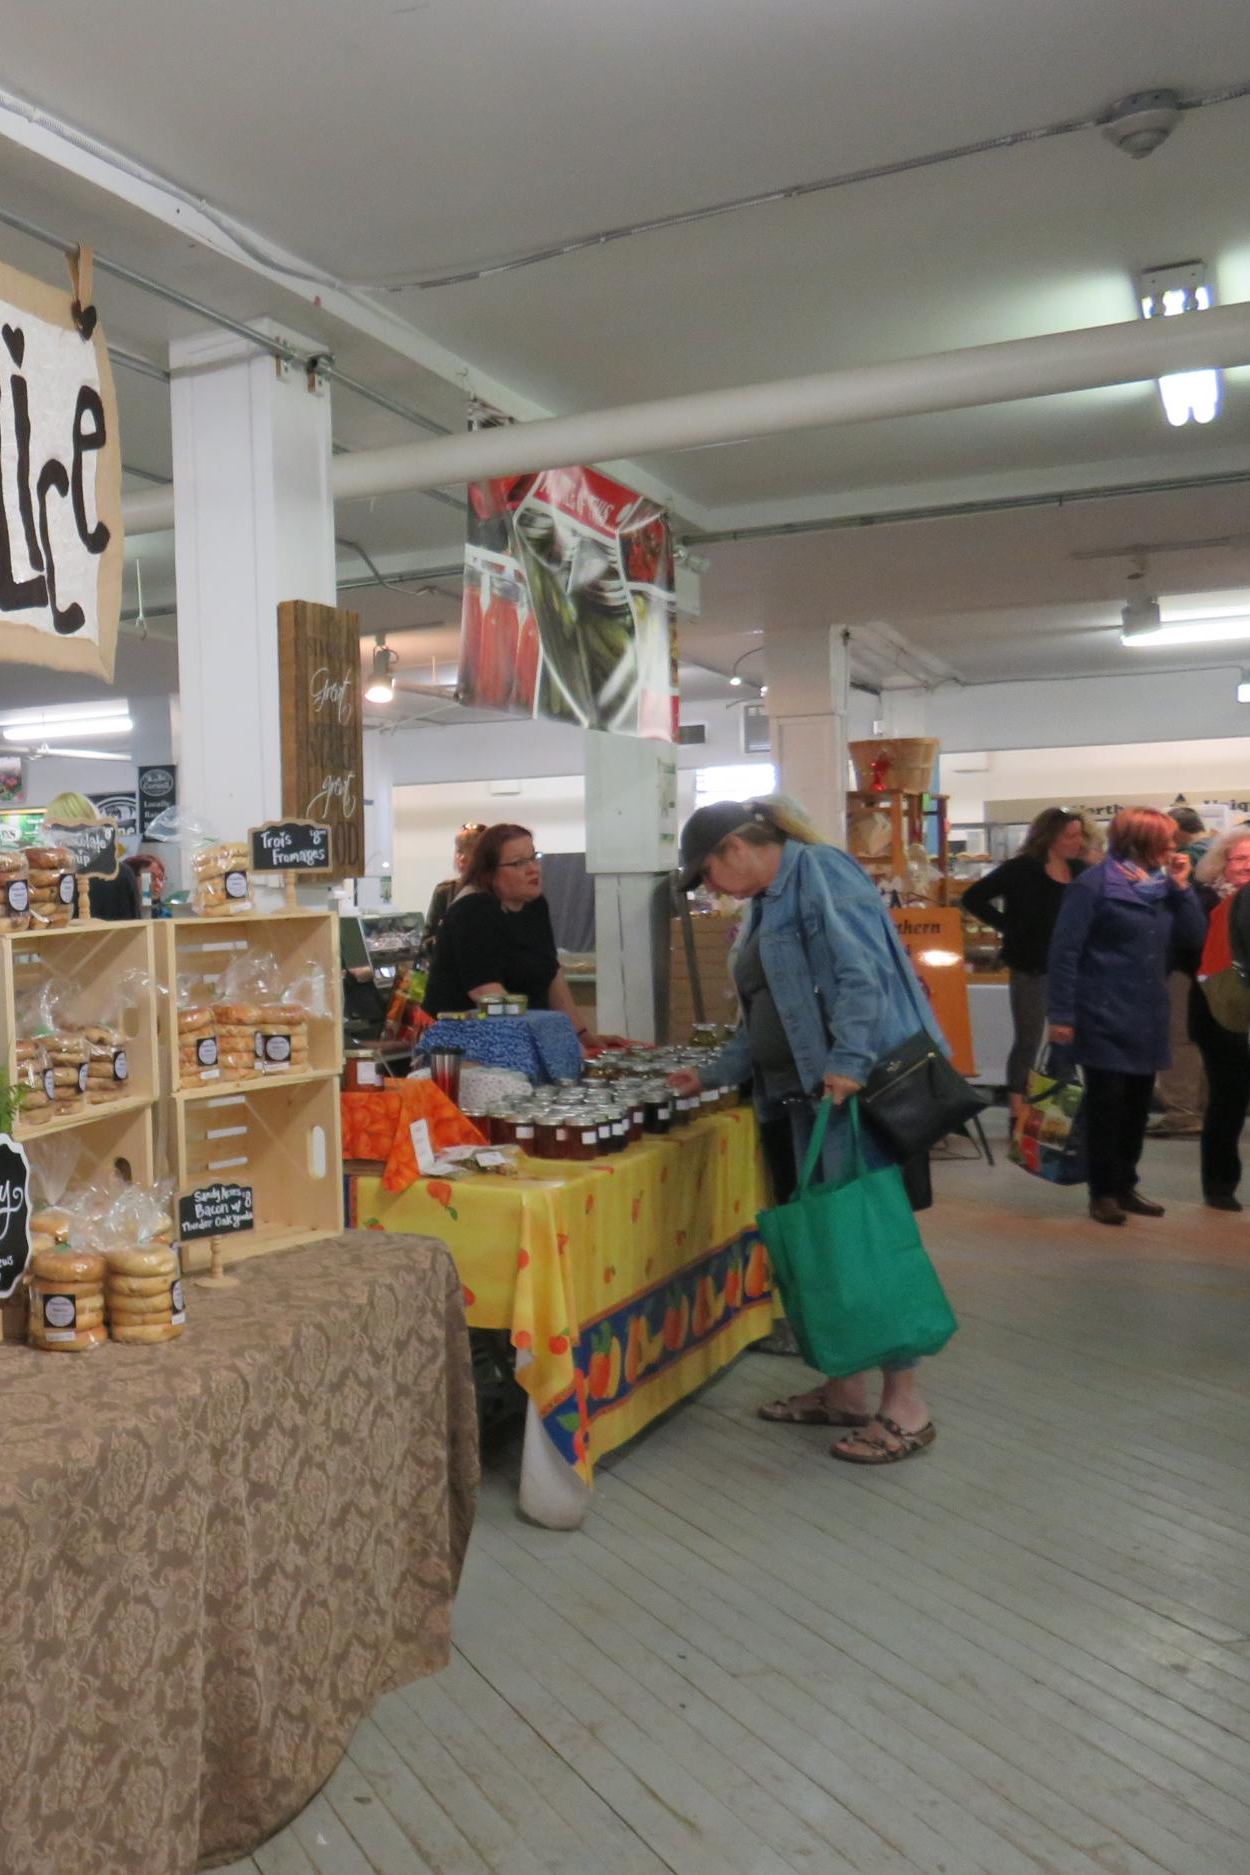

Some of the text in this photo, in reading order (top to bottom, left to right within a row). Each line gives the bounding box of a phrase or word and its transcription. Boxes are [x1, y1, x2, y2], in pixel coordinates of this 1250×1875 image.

[261, 831, 293, 849] Trois
[272, 849, 326, 866] Fromages
[195, 1203, 229, 1219] Bacon
